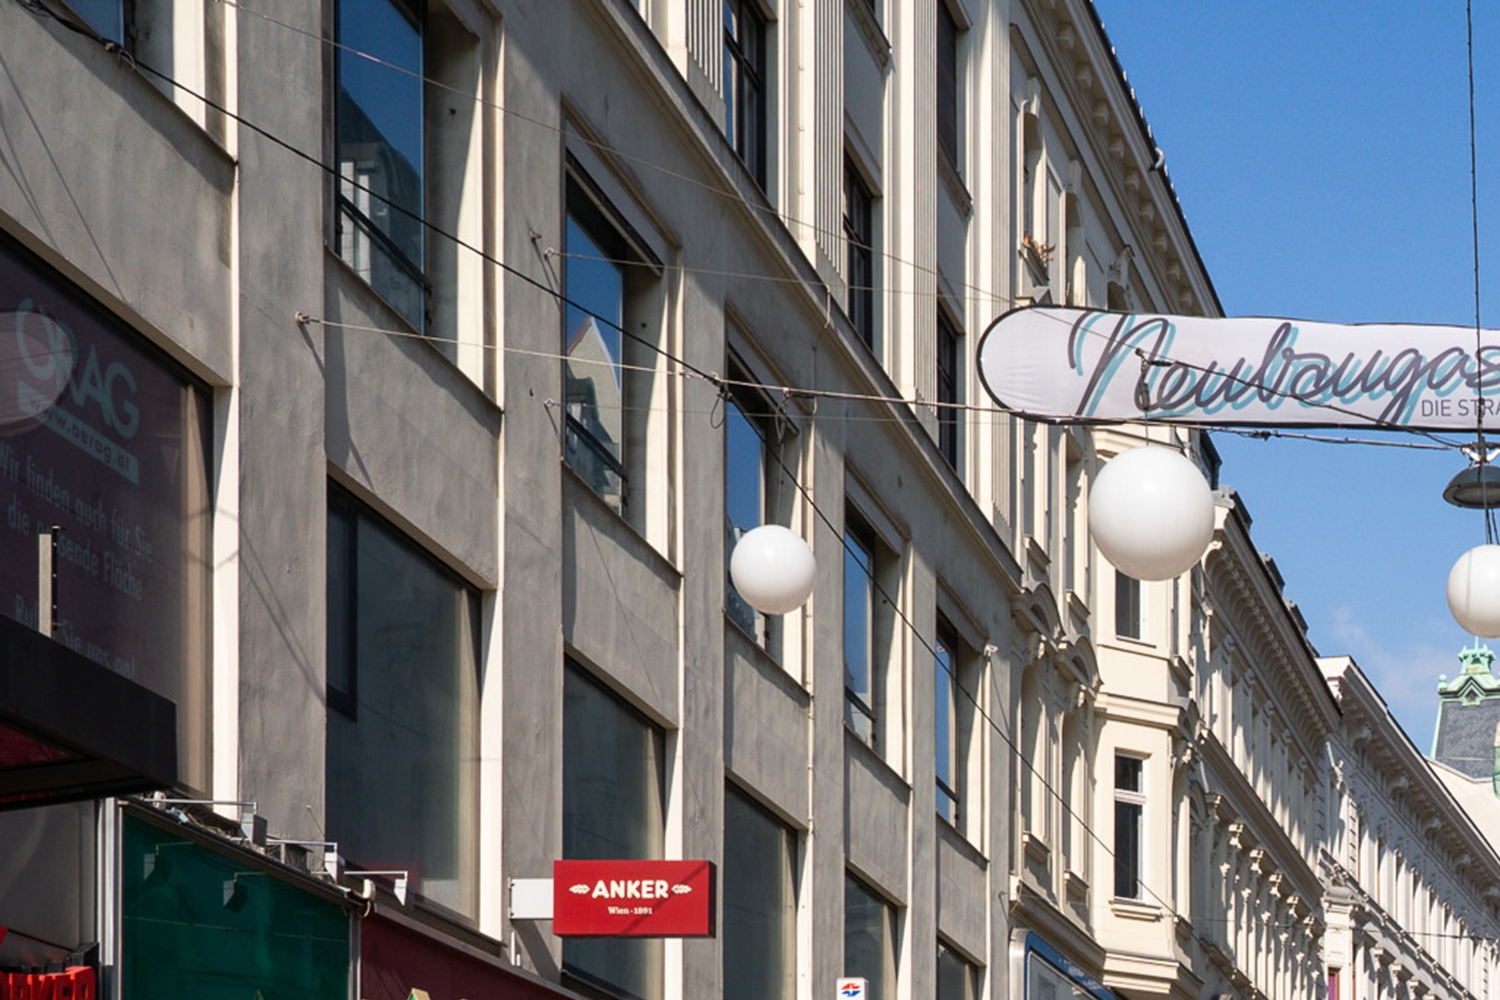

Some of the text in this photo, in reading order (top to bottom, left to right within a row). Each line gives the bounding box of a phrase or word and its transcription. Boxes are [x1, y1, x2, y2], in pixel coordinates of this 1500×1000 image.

[1421, 399, 1451, 417] DIE
[26, 455, 70, 513] finden
[75, 499, 106, 535] auch
[8, 495, 31, 536] die
[591, 879, 669, 899] ANKER
